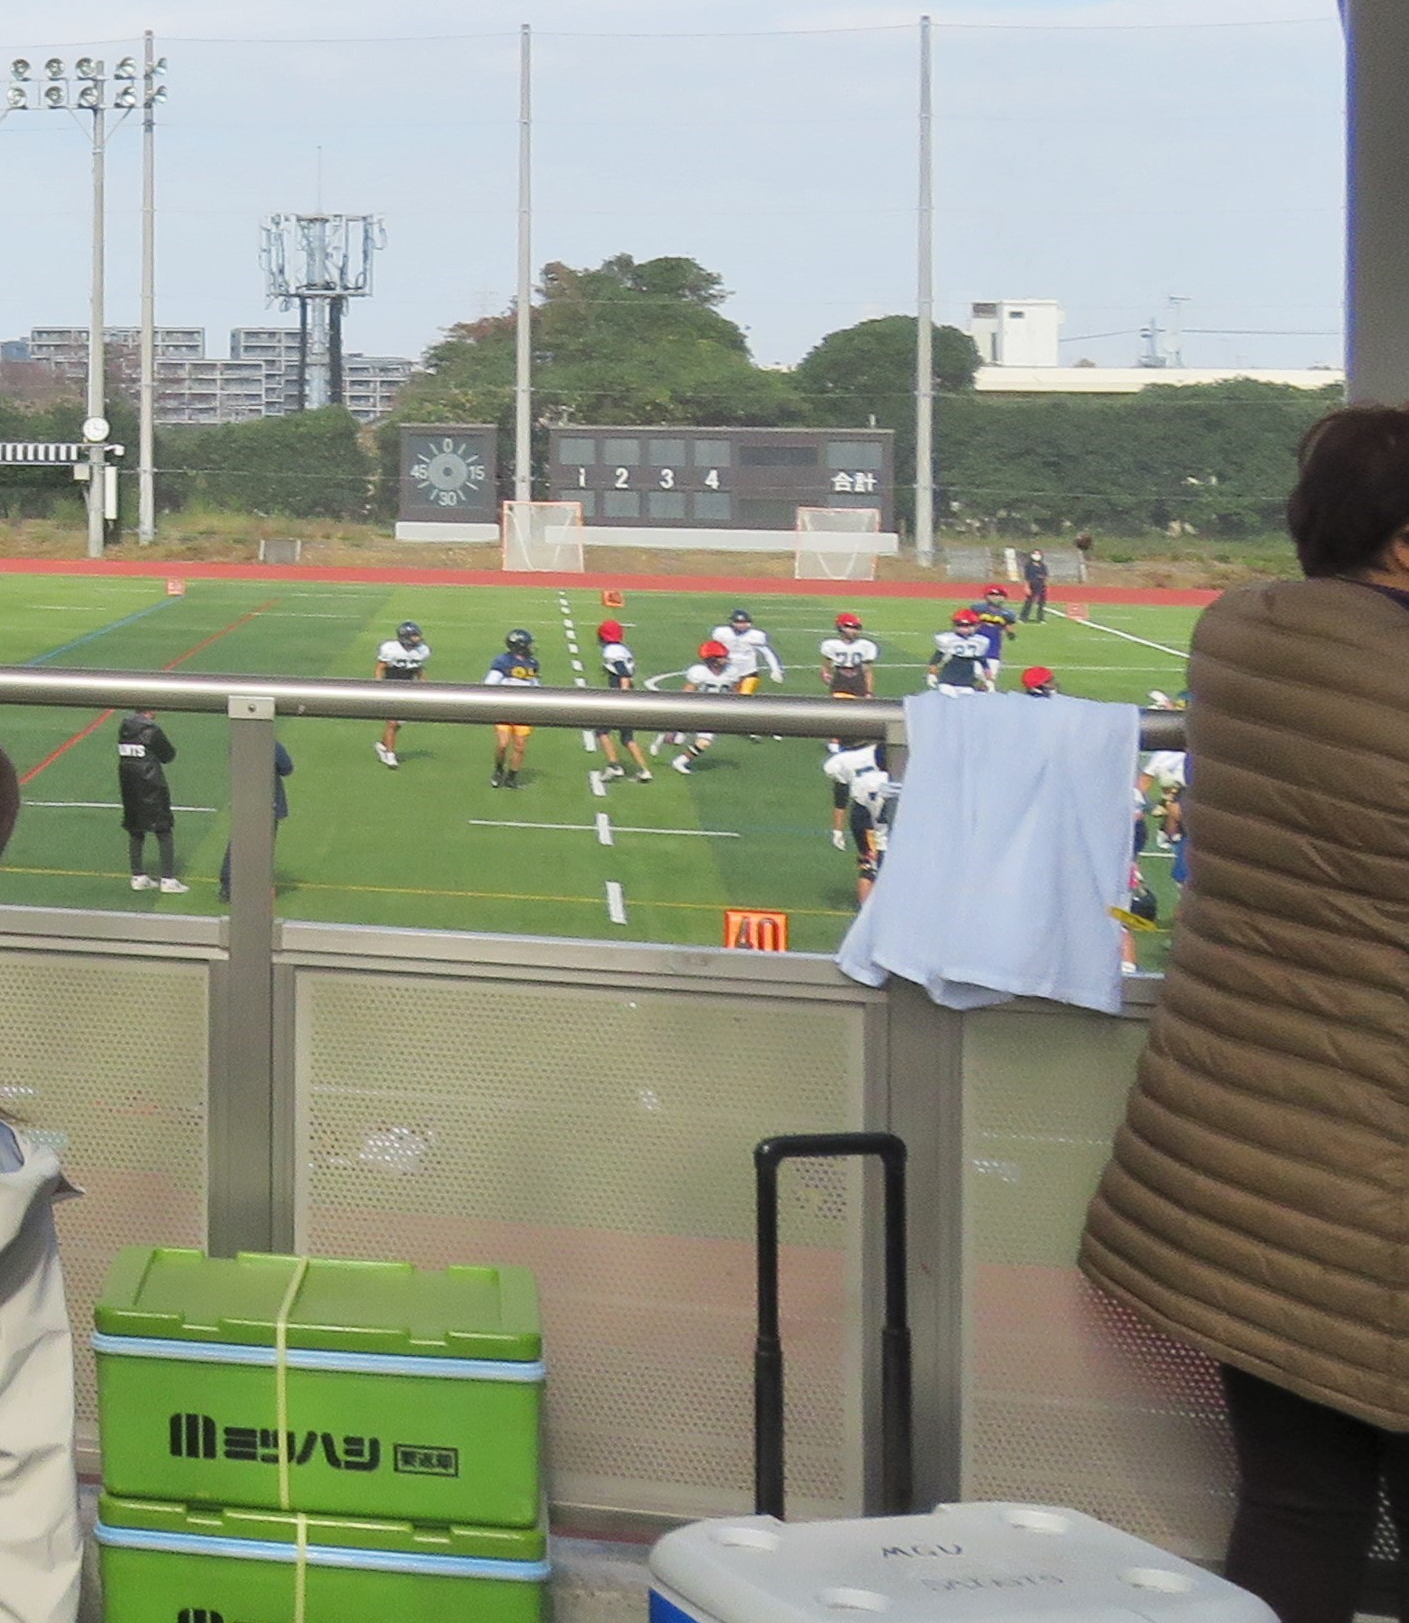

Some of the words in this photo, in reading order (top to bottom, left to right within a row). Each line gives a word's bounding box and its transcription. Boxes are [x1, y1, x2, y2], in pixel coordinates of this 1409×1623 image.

[443, 438, 453, 453] 0
[410, 464, 428, 480] 45
[469, 465, 485, 480] 15
[579, 467, 586, 488] 1
[615, 467, 629, 489] 2
[659, 468, 675, 489] 3
[704, 469, 720, 491] 4
[831, 471, 877, 492] 合計
[438, 491, 457, 506] 30
